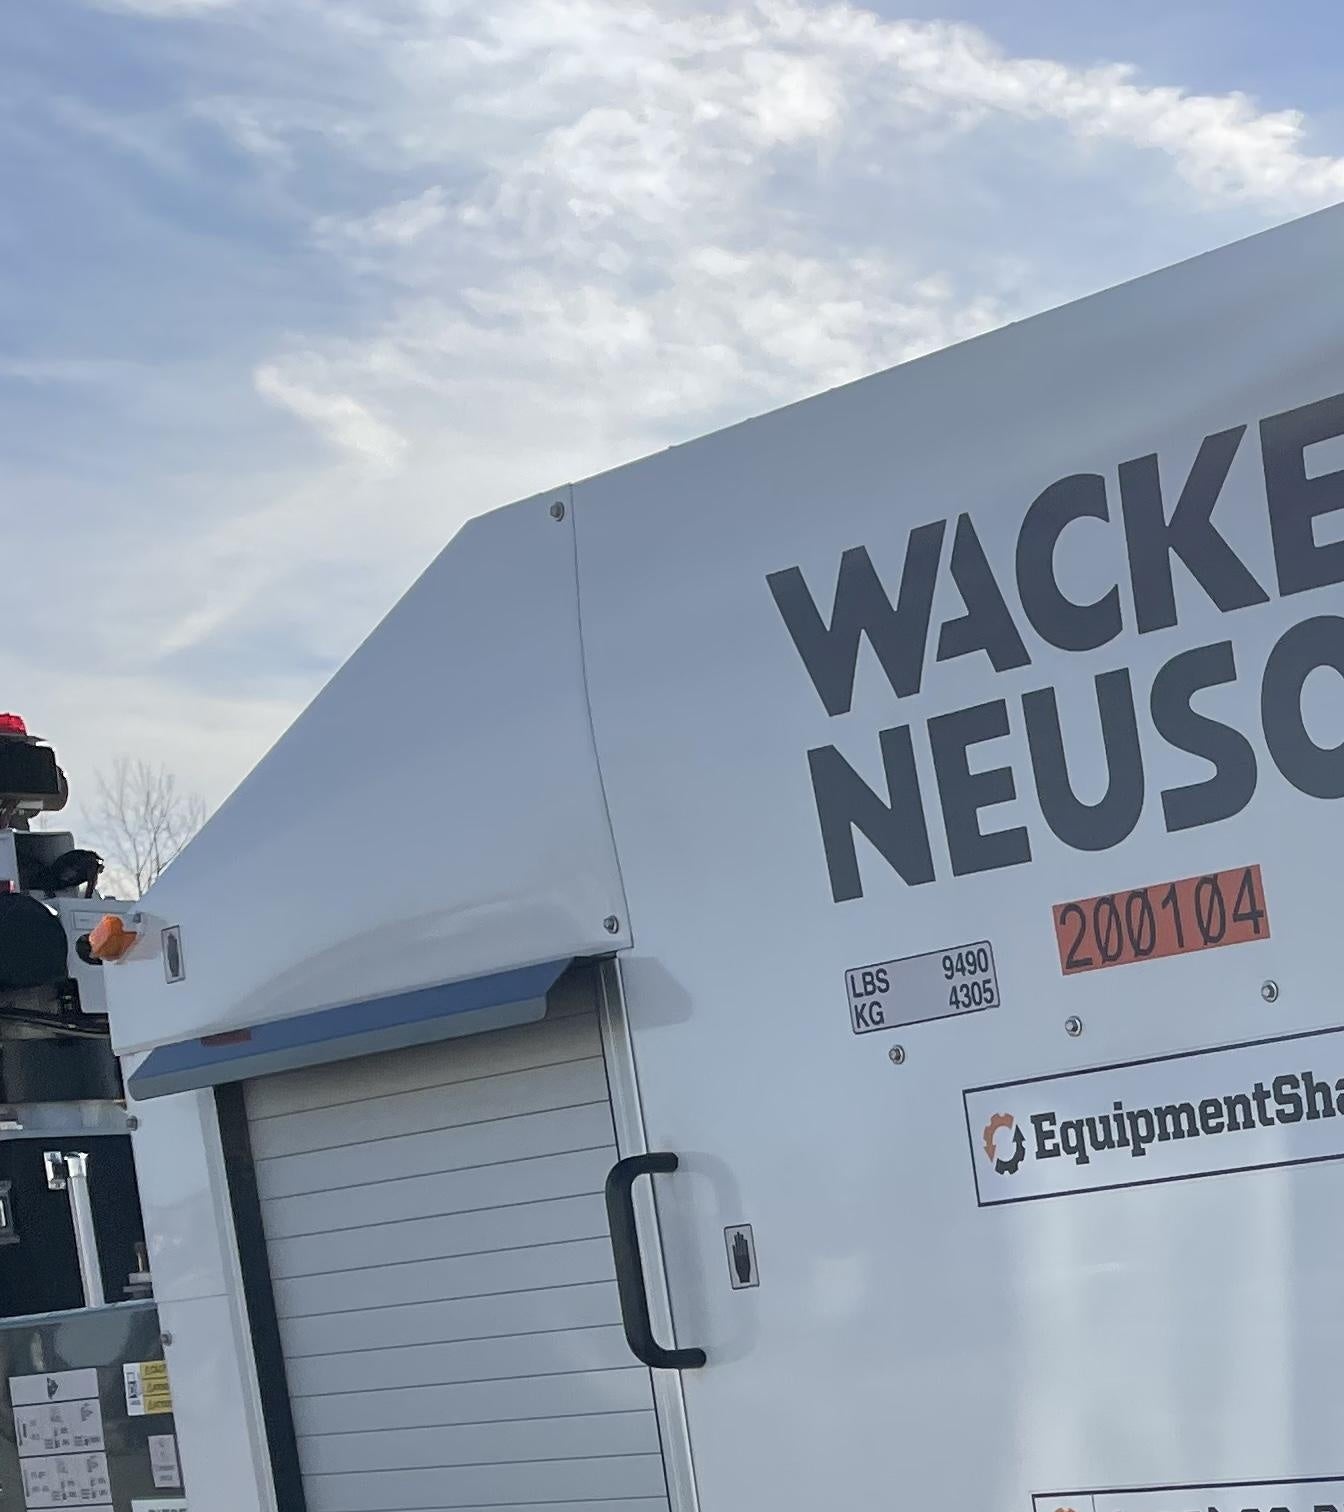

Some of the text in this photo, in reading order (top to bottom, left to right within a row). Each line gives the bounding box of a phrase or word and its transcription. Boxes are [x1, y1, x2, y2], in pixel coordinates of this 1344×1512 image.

[1060, 866, 1264, 969] 200104
[850, 947, 989, 999] LBS 9490
[853, 978, 995, 1029] KG 4305
